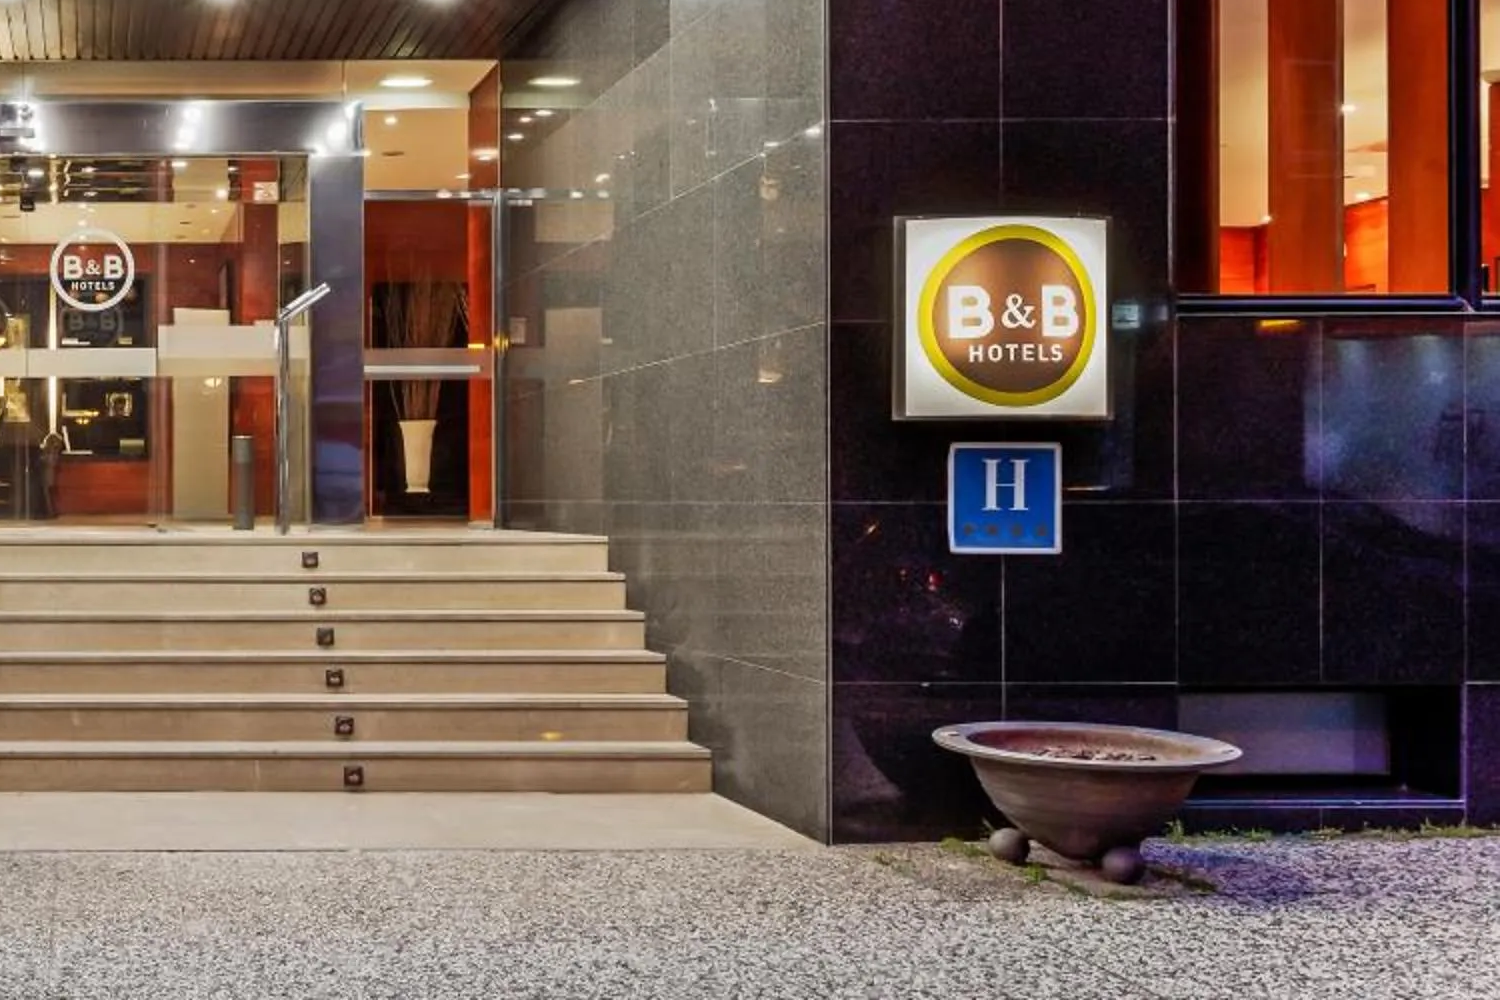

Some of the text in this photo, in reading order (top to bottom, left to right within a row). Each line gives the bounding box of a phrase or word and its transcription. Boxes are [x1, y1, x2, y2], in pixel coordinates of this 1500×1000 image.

[63, 254, 125, 280] B&B
[71, 281, 115, 291] HOTELS
[947, 285, 1080, 339] B&B
[968, 343, 1064, 363] HOTELS
[981, 458, 1031, 511] H
